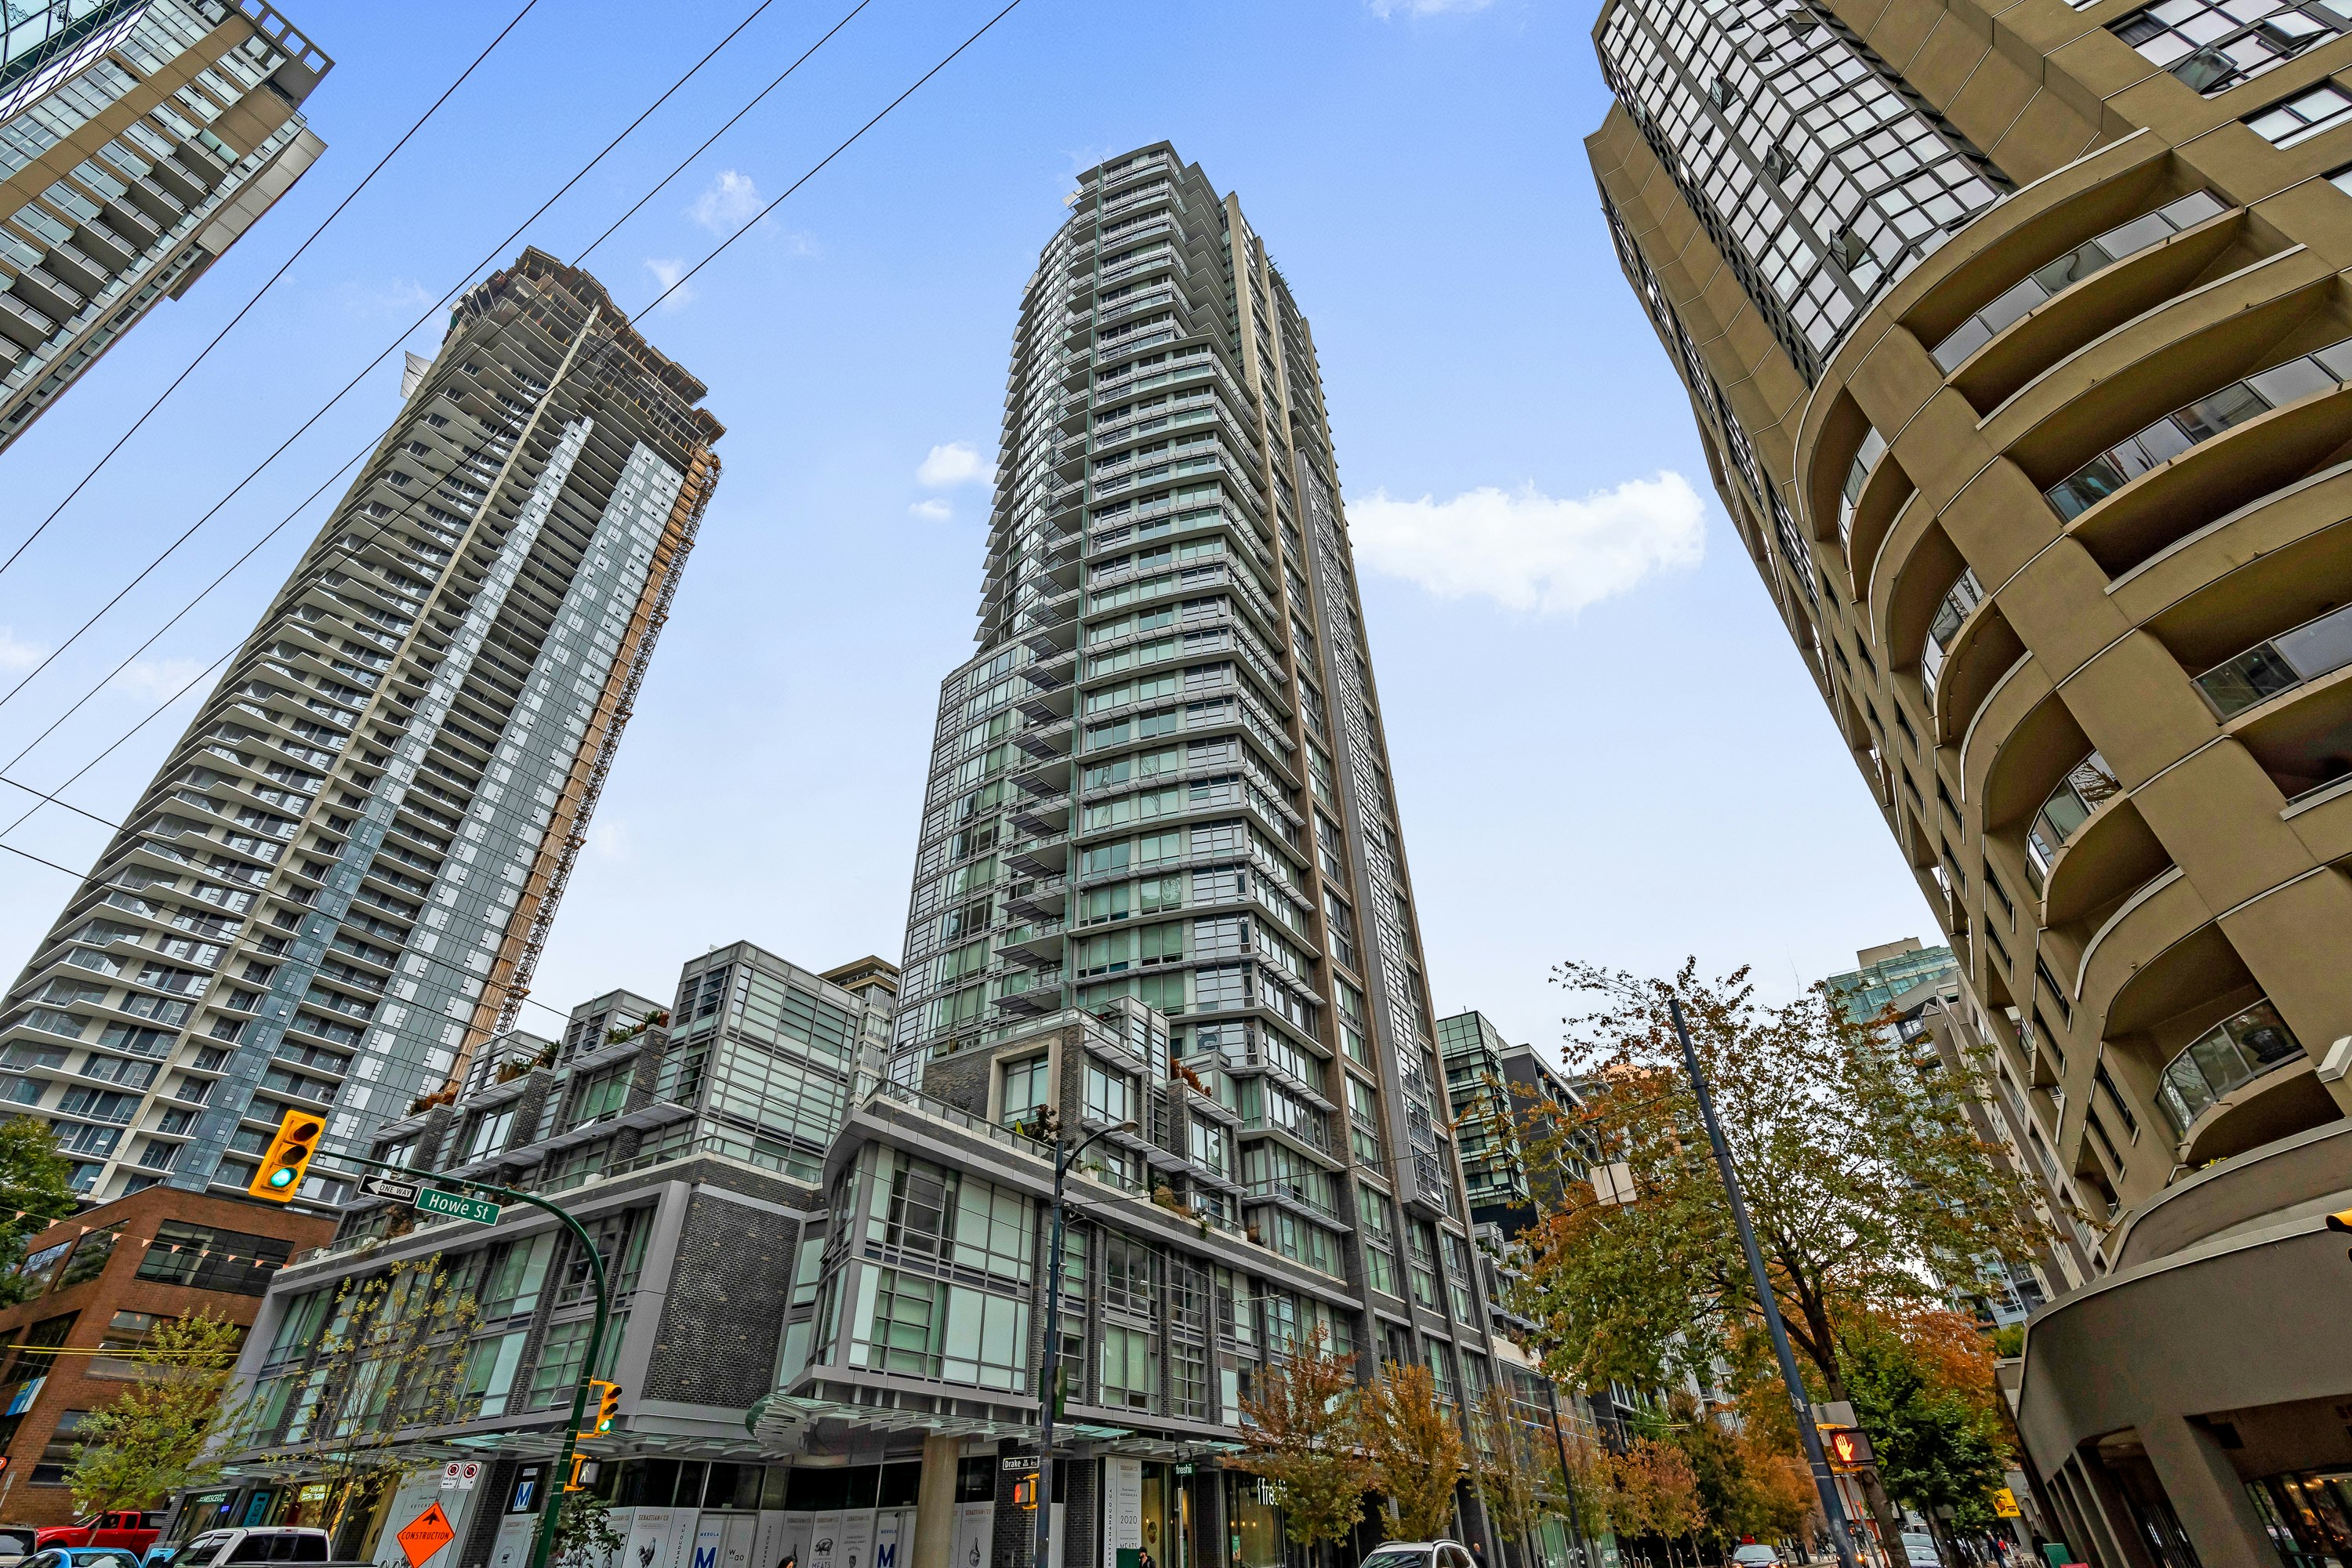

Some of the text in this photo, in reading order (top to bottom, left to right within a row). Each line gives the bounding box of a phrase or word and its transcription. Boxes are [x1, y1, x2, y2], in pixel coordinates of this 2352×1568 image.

[379, 1184, 412, 1197] ONE WAY
[429, 1193, 488, 1220] Howe St
[1005, 1460, 1022, 1468] Drake
[1175, 1464, 1192, 1475] freshii
[514, 1483, 535, 1507] M
[1120, 1515, 1138, 1524] 2020
[401, 1531, 450, 1541] CONSTRUCTION
[694, 1547, 717, 1568] M
[877, 1544, 895, 1568] M
